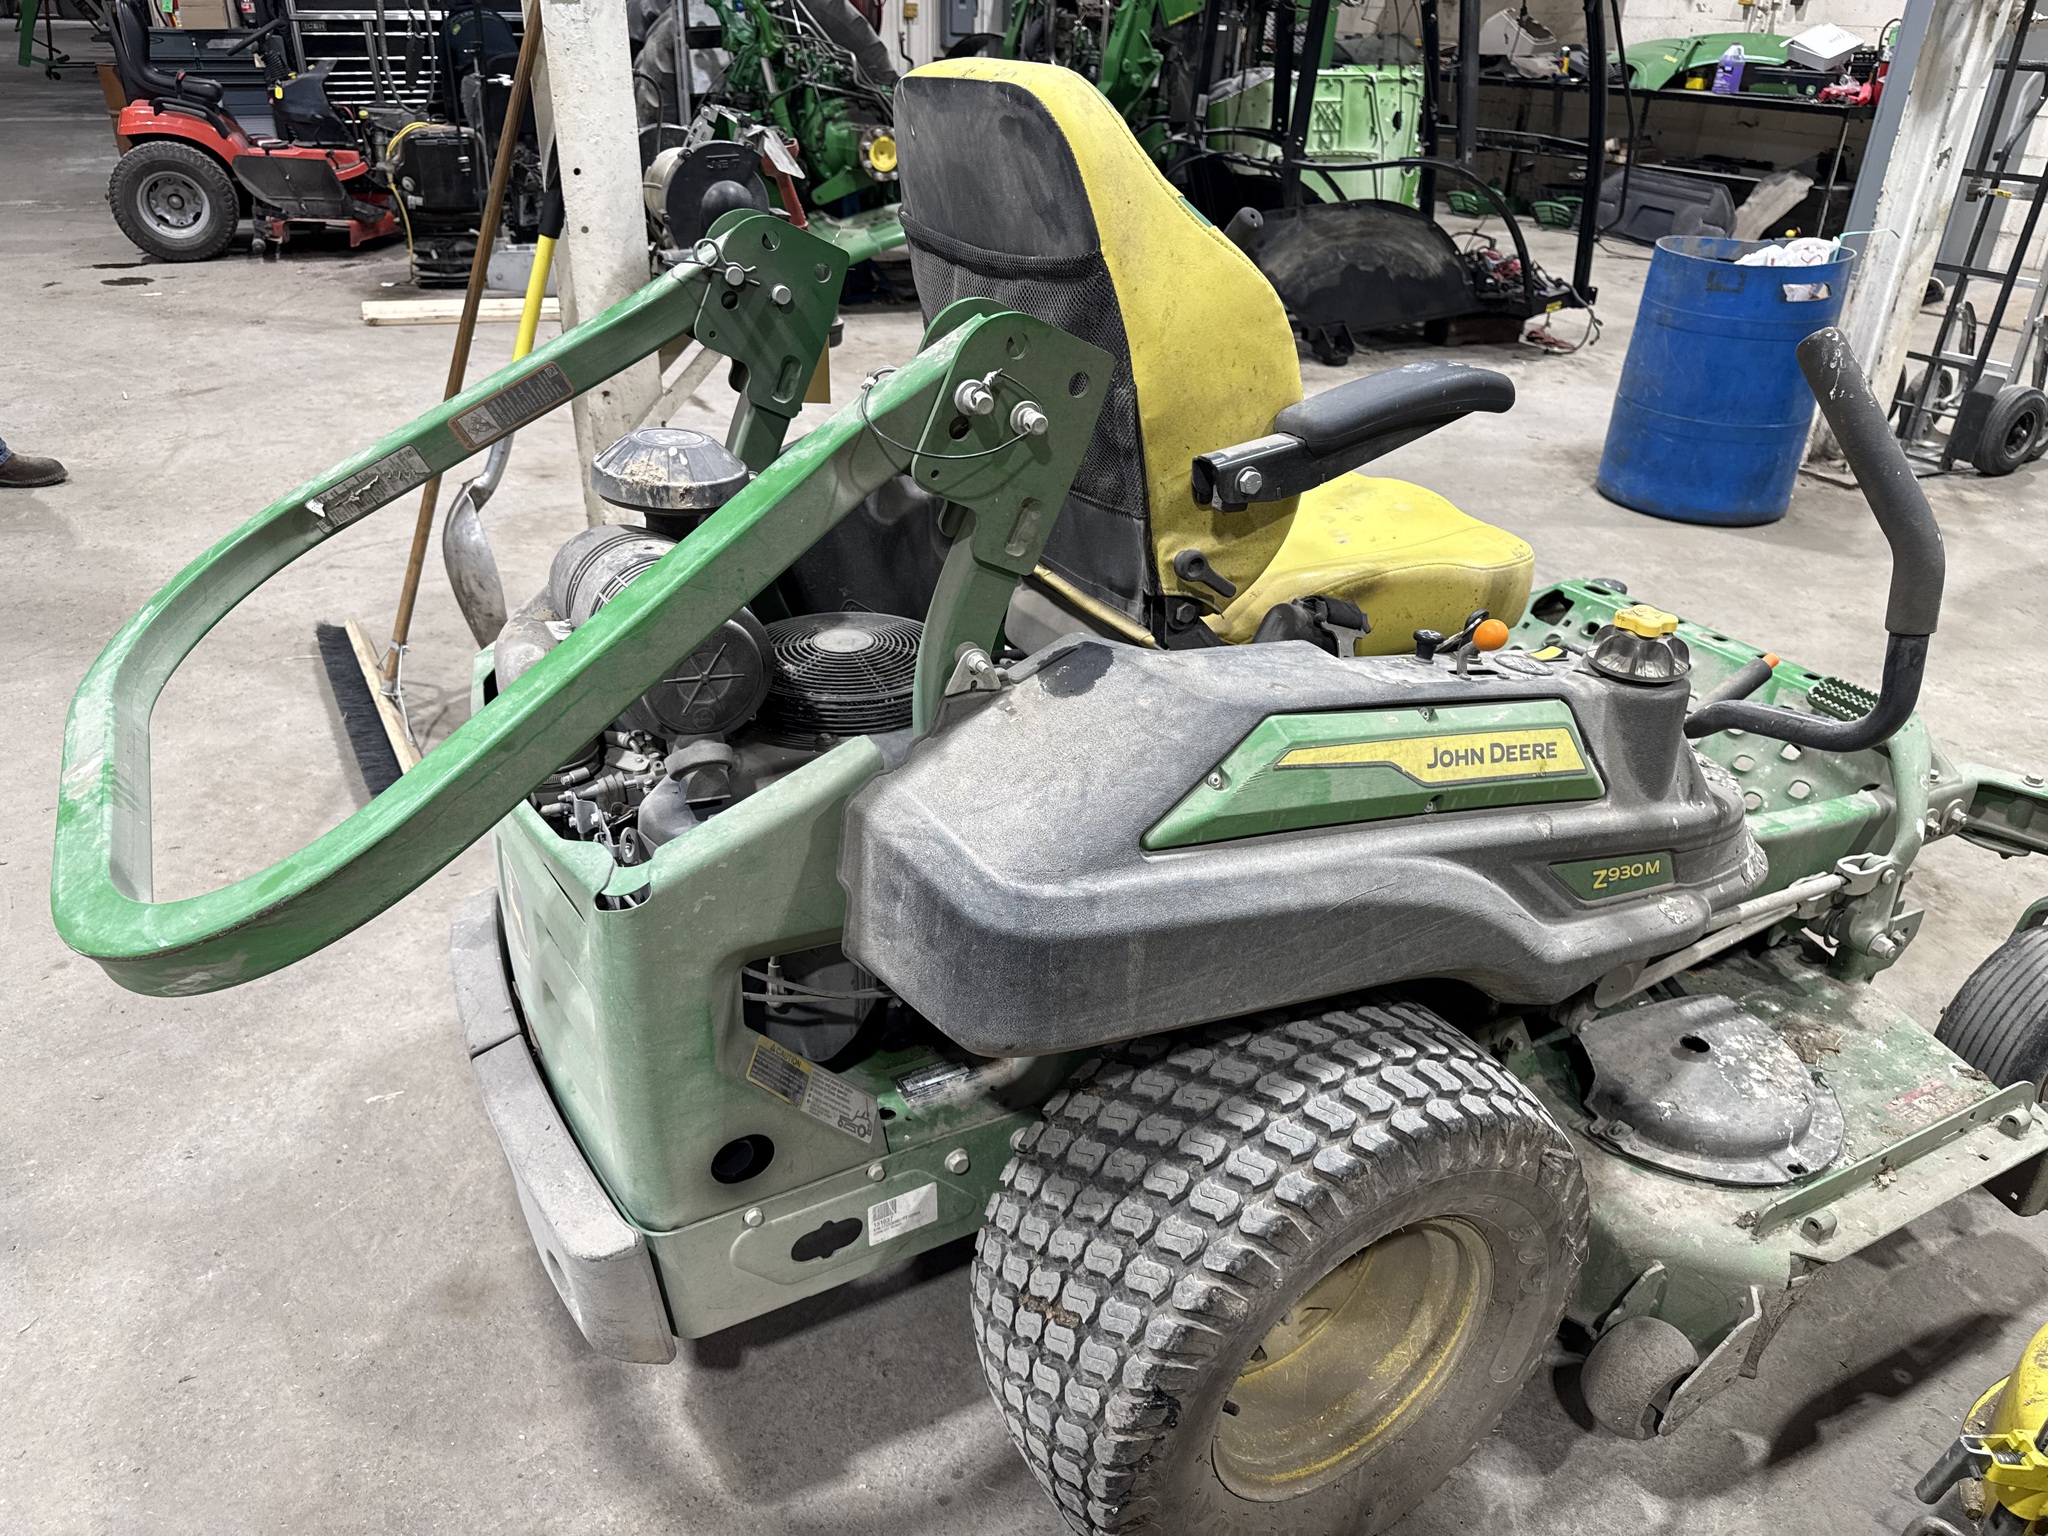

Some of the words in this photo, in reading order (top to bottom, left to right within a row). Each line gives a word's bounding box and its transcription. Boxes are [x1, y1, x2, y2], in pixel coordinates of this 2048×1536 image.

[706, 158, 740, 170] JET
[1427, 747, 1485, 769] JOHN
[1489, 741, 1557, 764] DEERE
[775, 1047, 802, 1068] CAUTION
